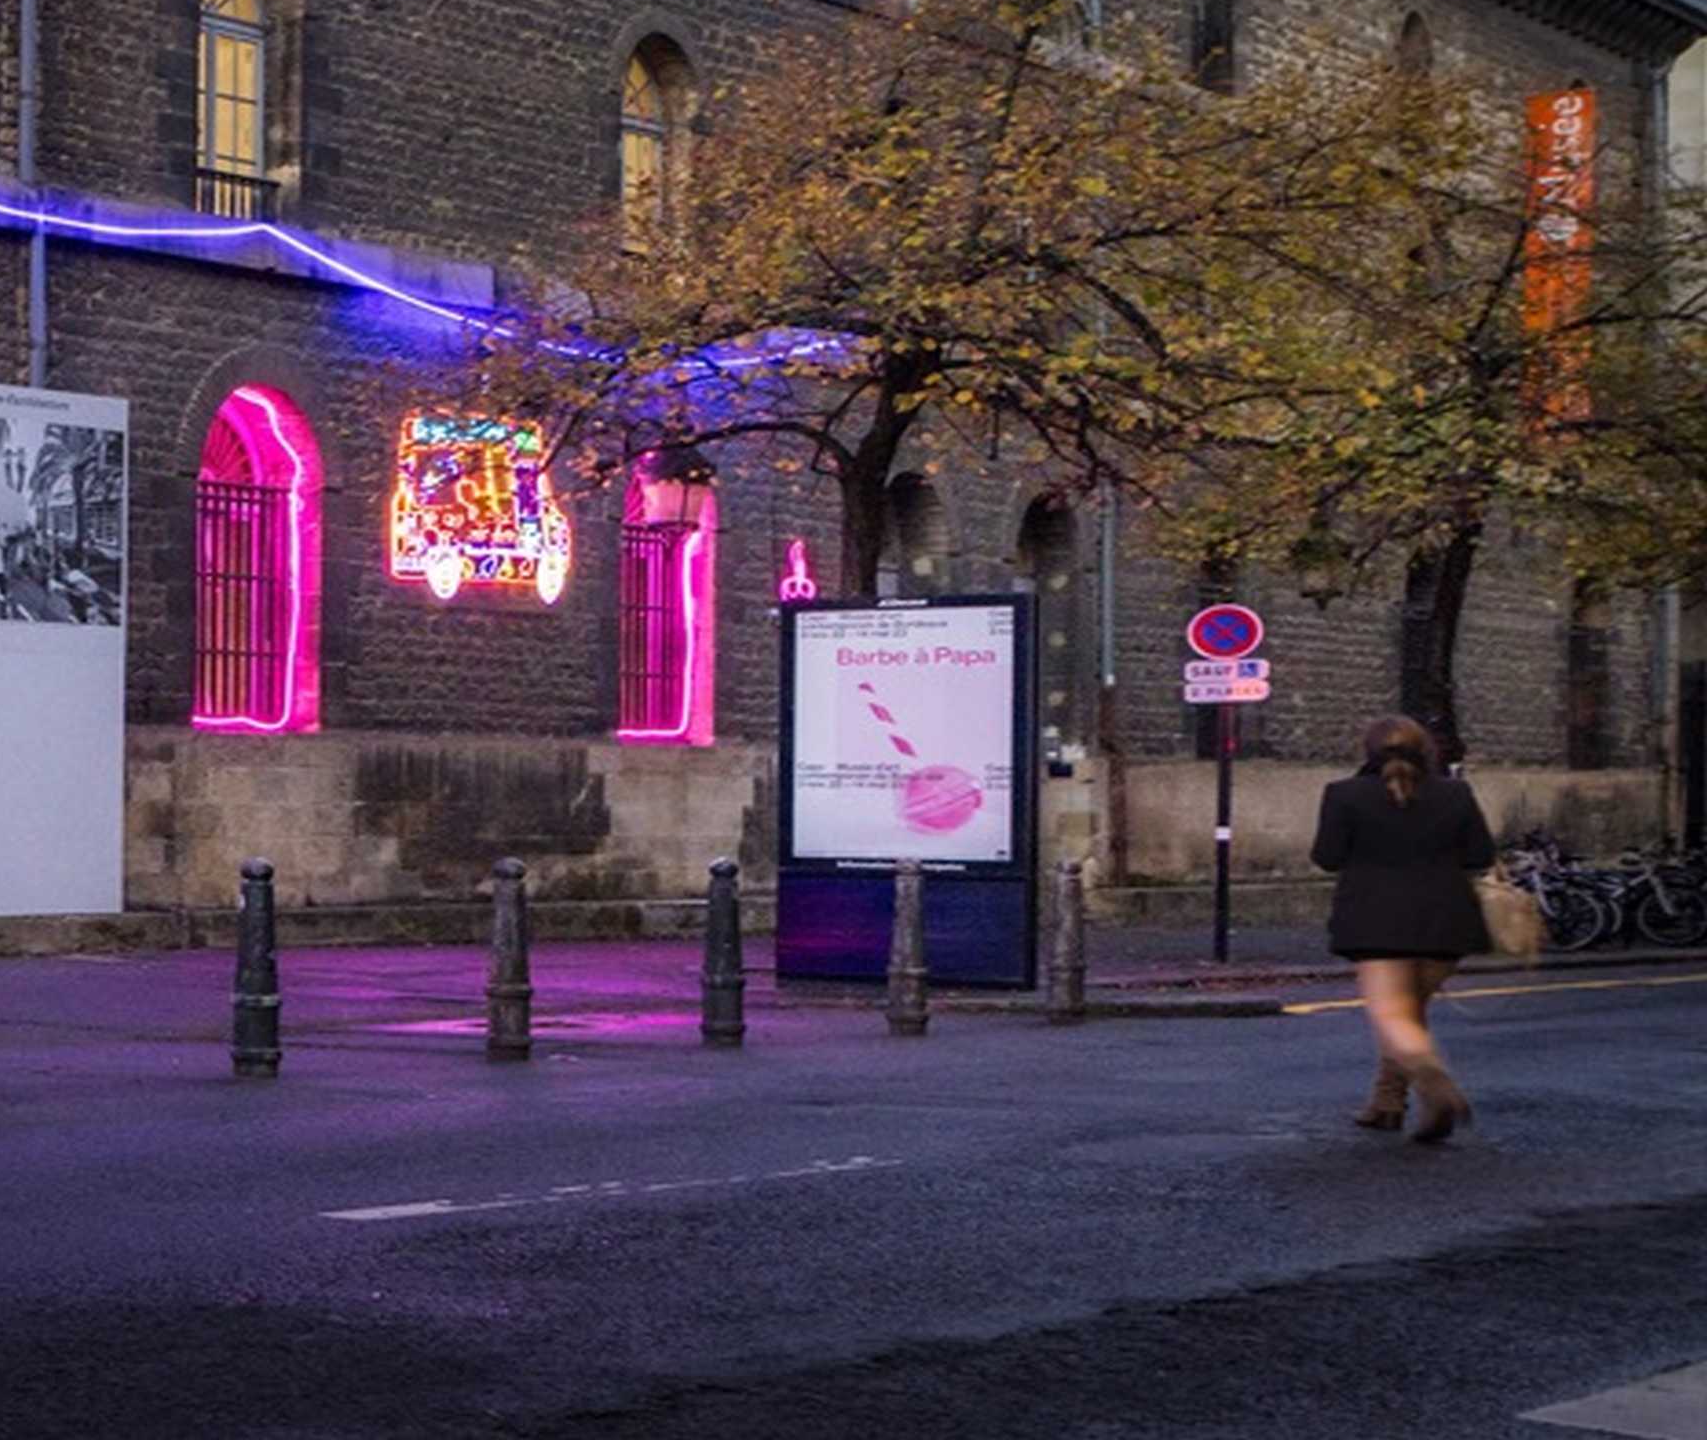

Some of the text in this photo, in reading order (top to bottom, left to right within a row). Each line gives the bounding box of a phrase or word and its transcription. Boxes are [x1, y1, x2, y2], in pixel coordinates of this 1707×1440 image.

[837, 646, 996, 668] Barbe à Papa
